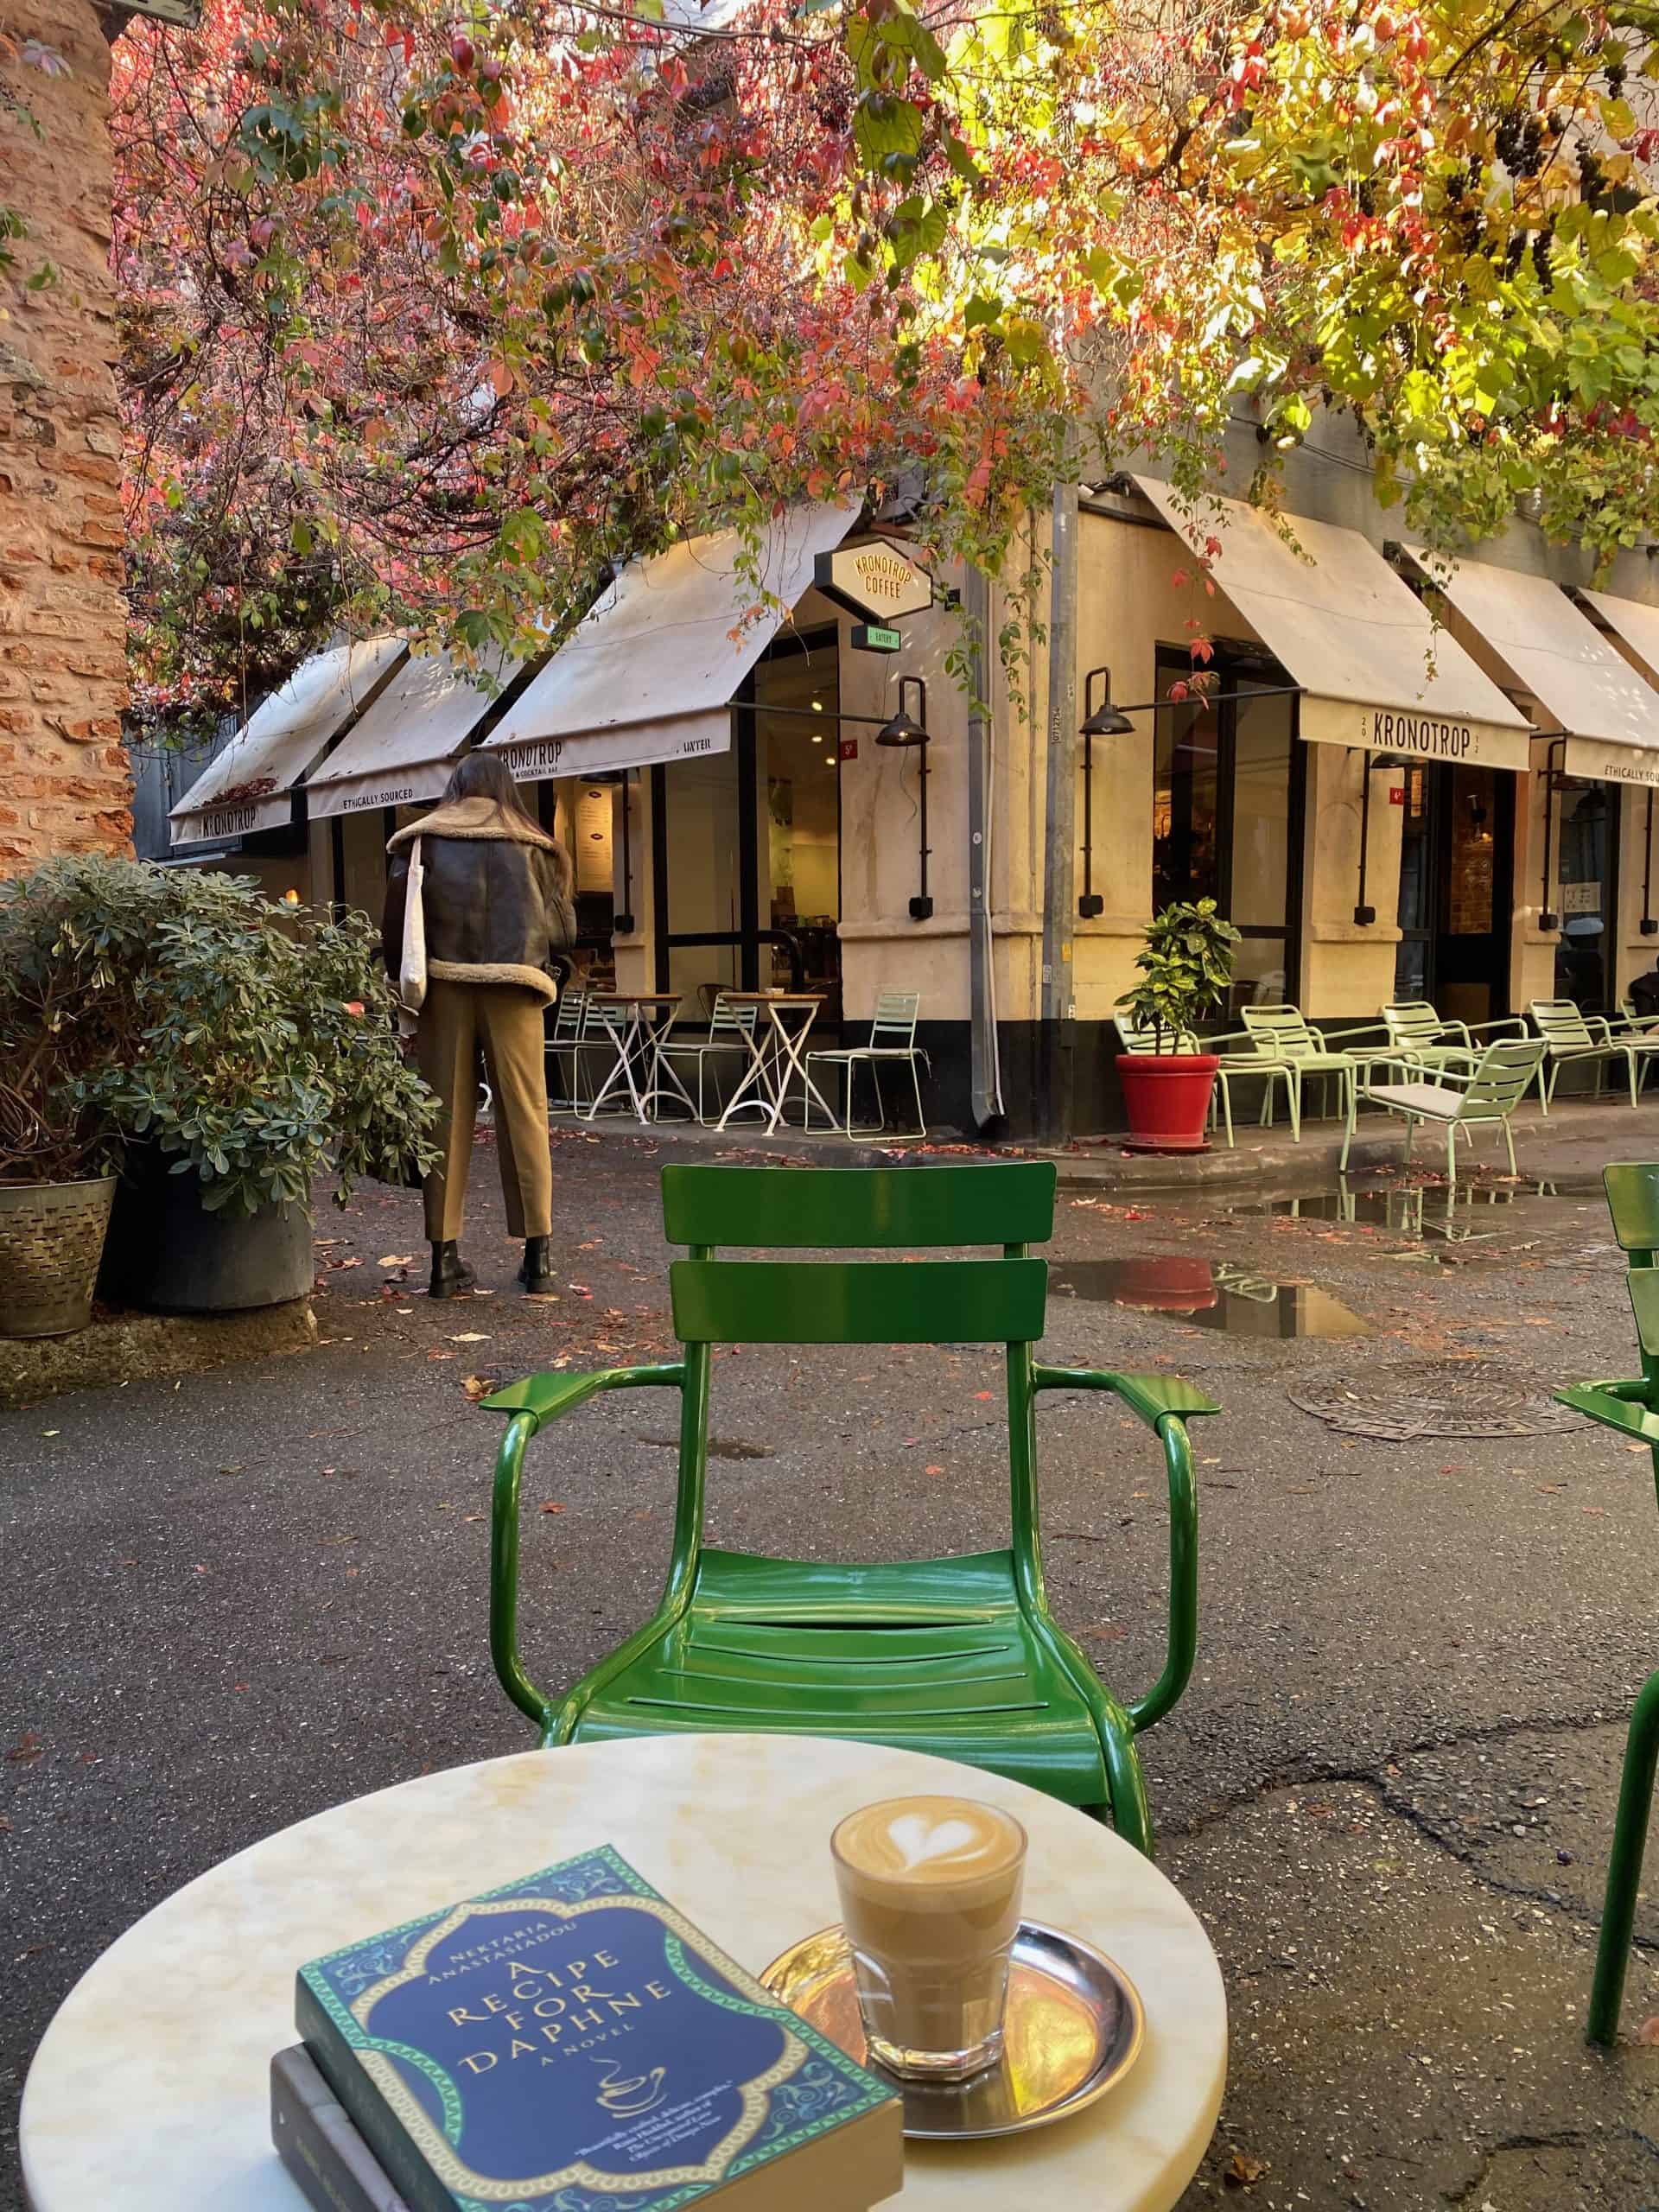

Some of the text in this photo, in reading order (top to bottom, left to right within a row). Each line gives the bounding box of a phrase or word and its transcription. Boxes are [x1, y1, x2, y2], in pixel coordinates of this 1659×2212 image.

[854, 554, 912, 584] KRONOTROP
[865, 575, 900, 598] COFFEE
[1374, 712, 1470, 758] KRONOTROP
[1605, 764, 1643, 779] ETHICALLY
[343, 788, 413, 810] ETHICALLY SOURCED
[203, 806, 256, 837] KRONOTROP
[429, 1922, 577, 1985] ANASTASIADOU
[449, 1922, 548, 1963] NEKTARIA
[447, 1949, 620, 2026] RECIPE
[507, 1961, 546, 1980] A
[457, 1980, 671, 2075] DAPHNE
[505, 1985, 615, 2031] FOR
[541, 2024, 635, 2066] A NOVEL
